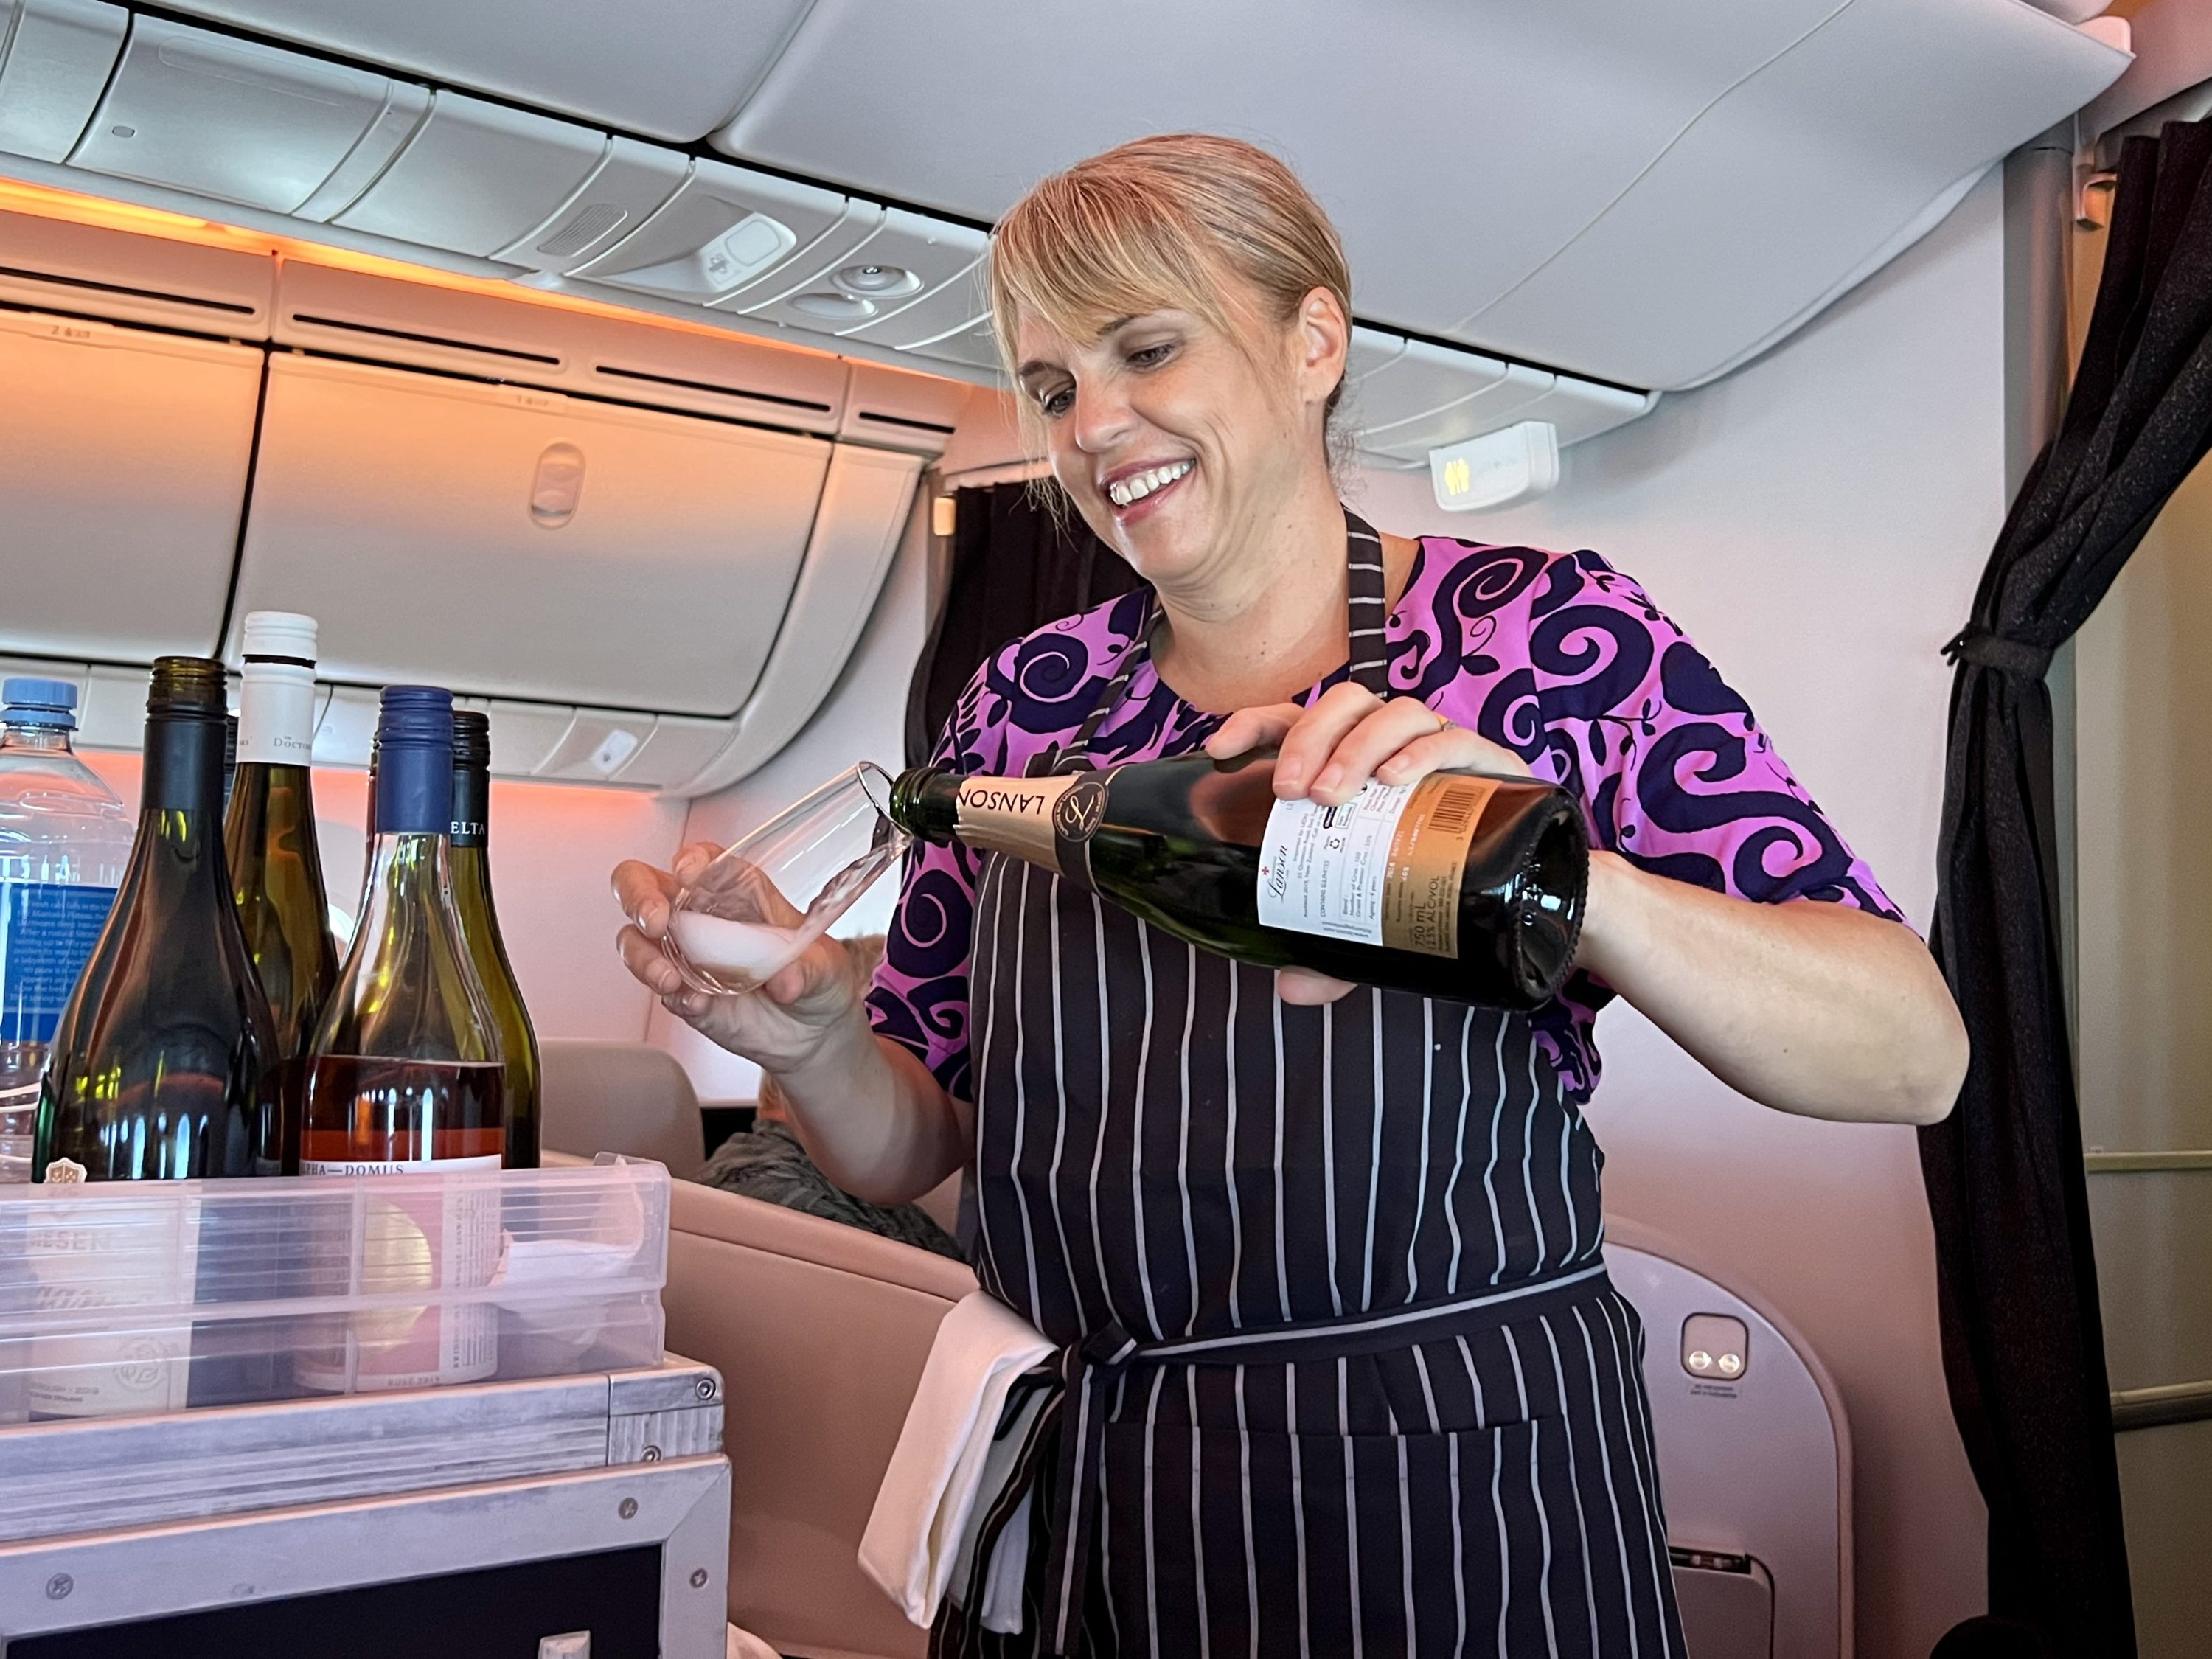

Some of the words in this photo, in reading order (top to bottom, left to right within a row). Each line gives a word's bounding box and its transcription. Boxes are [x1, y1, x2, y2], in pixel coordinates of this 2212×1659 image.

[959, 789, 1045, 815] LANSON
[1267, 845, 1287, 903] Lanson
[1426, 875, 1440, 922] ALC/VOL
[1414, 902, 1426, 922] mL
[1414, 925, 1427, 948] 750
